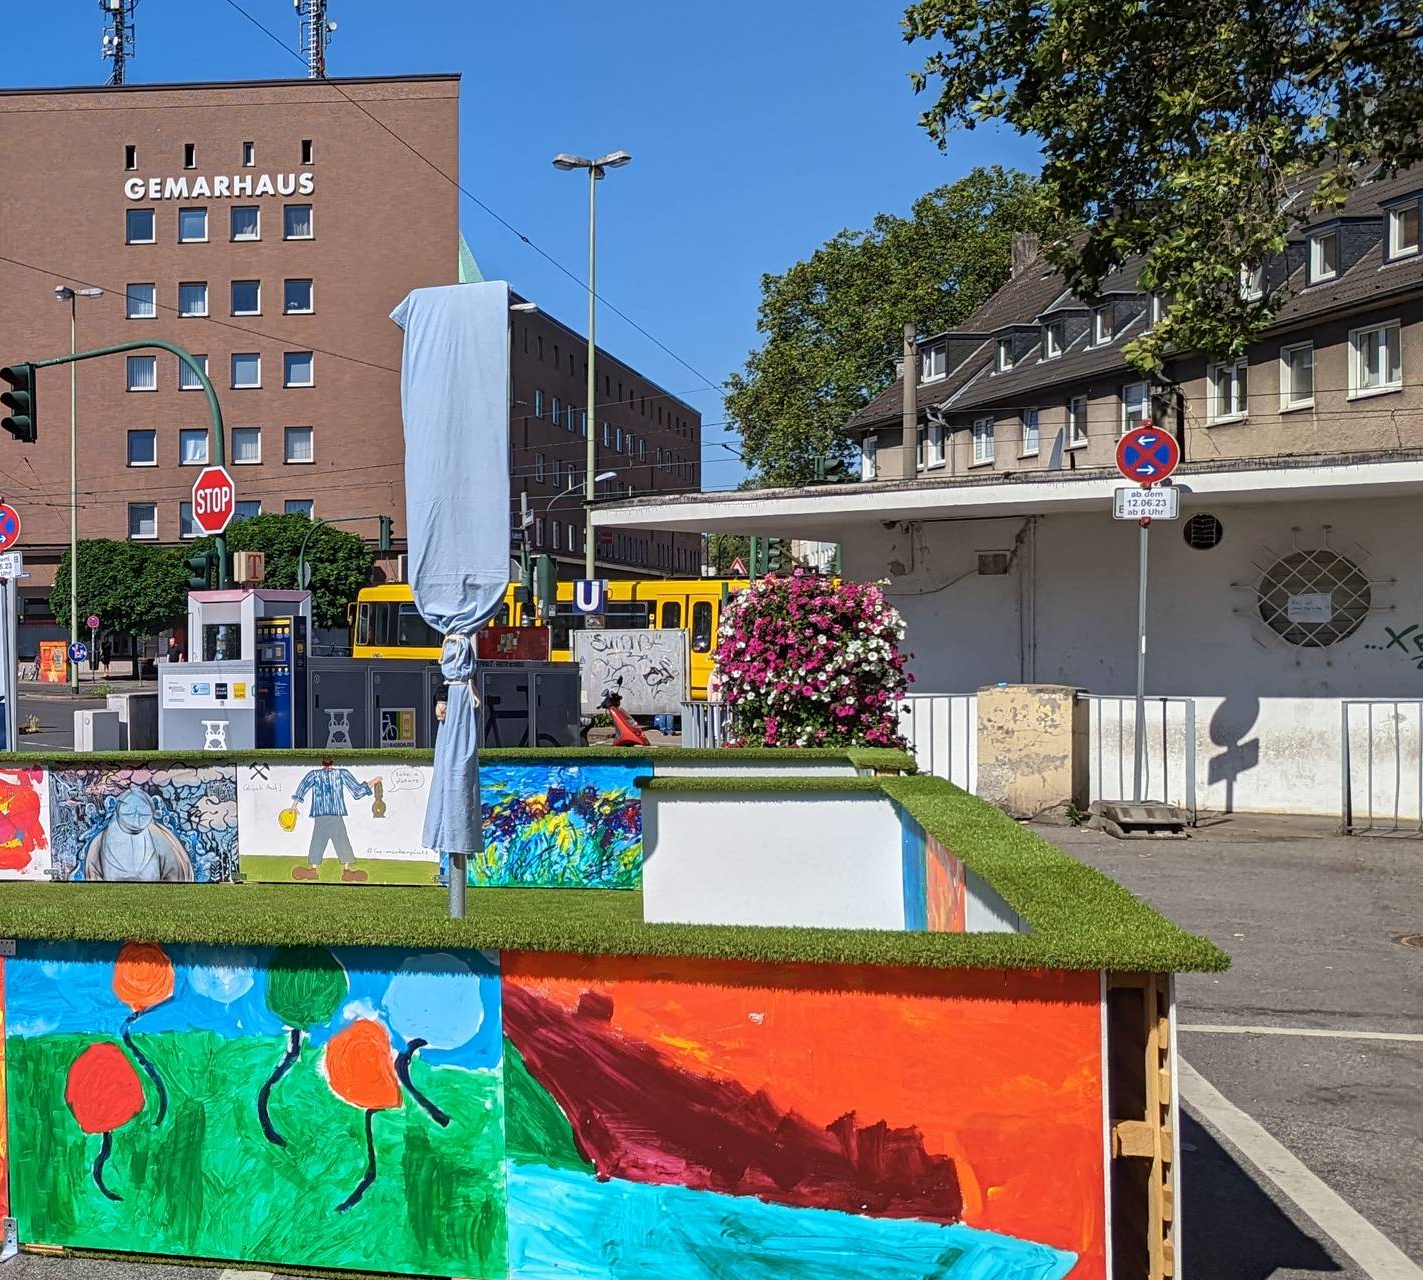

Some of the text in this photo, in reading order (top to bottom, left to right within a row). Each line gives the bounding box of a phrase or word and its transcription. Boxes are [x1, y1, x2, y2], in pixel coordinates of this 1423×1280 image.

[124, 172, 315, 200] GEMARHAUS
[197, 486, 230, 514] STOP
[1148, 508, 1164, 516] Uhr
[247, 554, 262, 579] T
[576, 581, 600, 612] U
